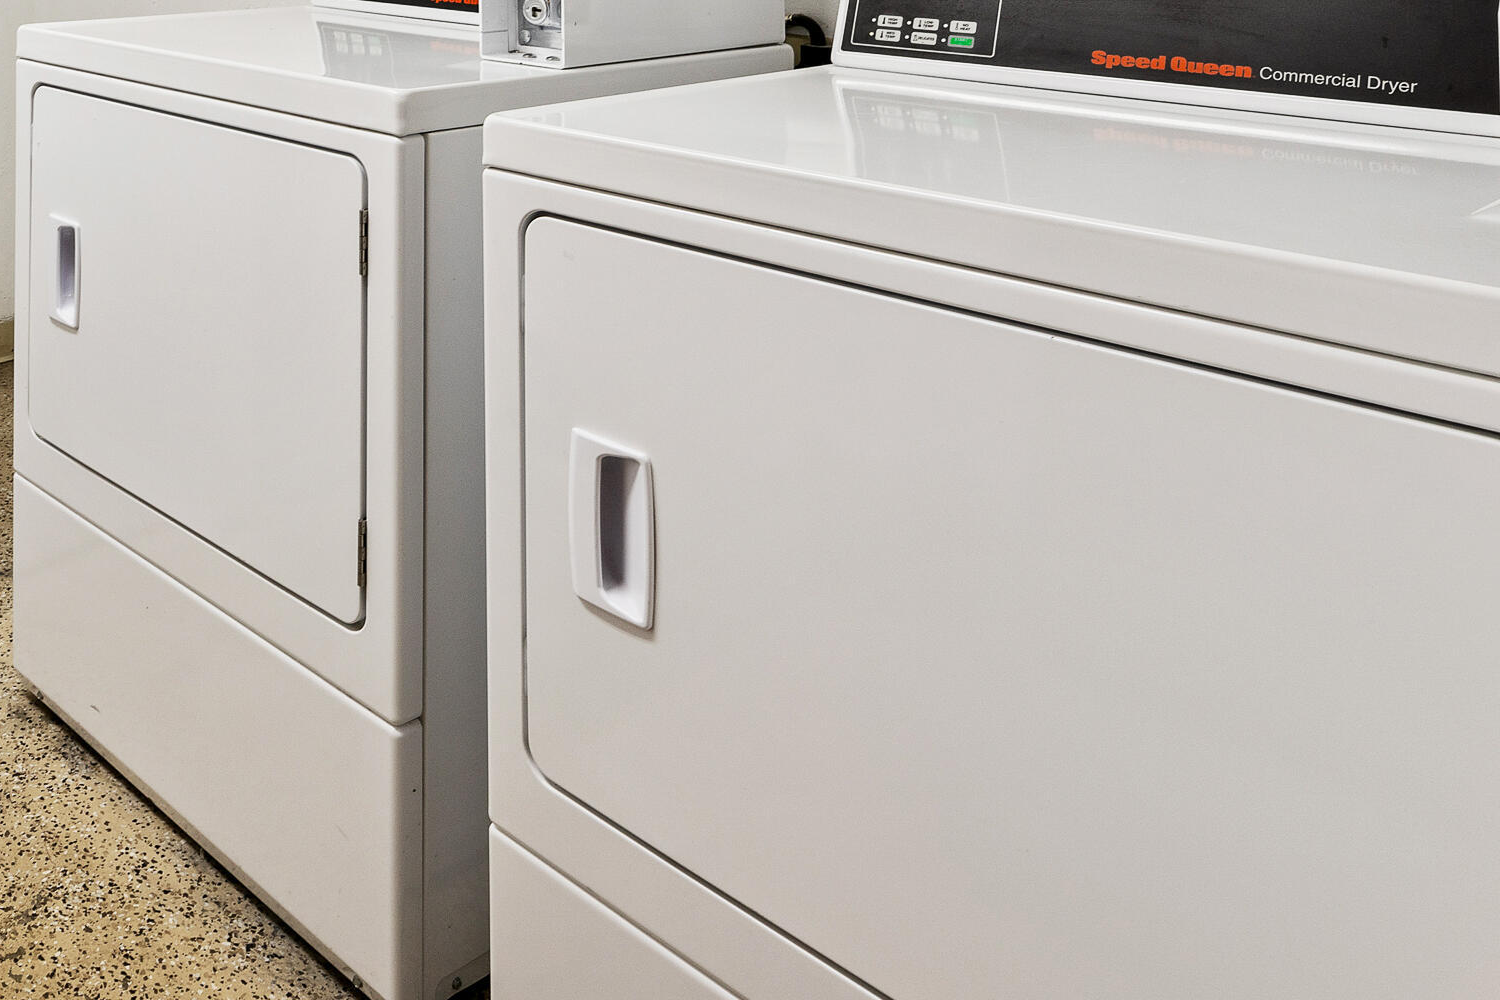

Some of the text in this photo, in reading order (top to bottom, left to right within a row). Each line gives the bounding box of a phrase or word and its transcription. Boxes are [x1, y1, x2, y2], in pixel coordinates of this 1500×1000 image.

[1090, 50, 1419, 95] Speed Queen Commercial Dryer
